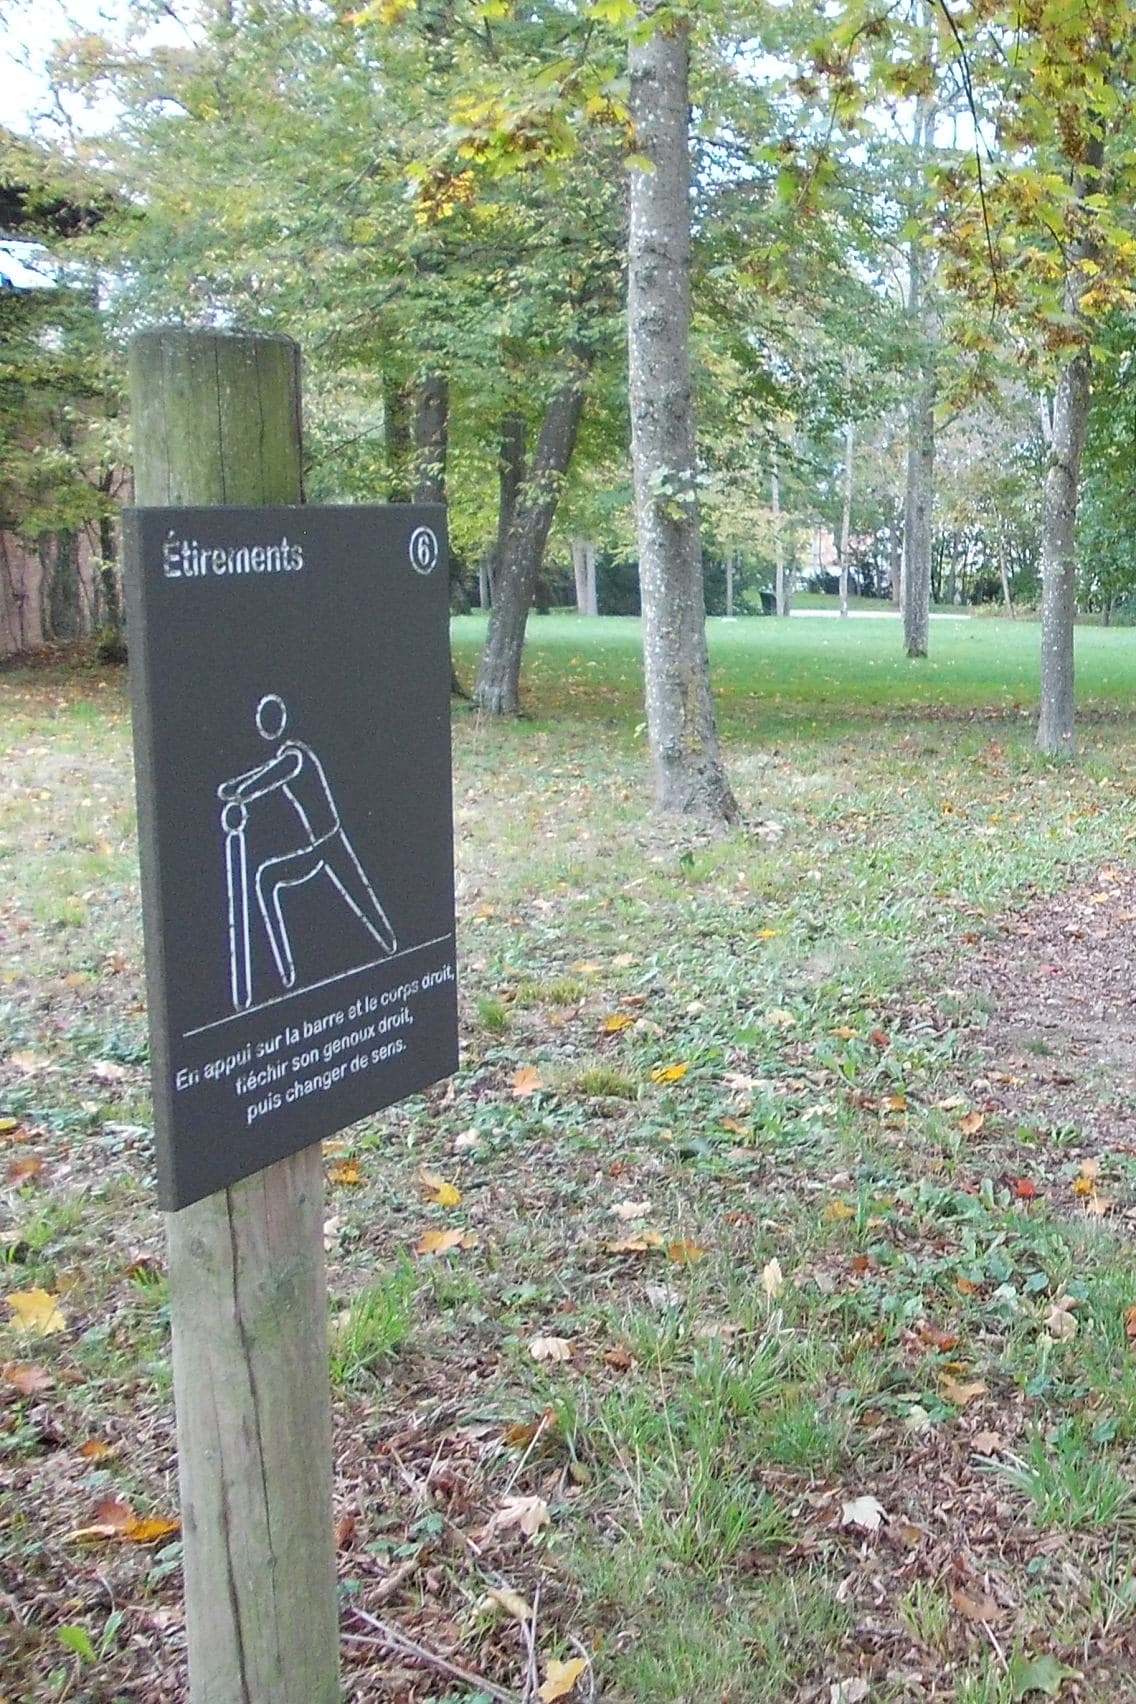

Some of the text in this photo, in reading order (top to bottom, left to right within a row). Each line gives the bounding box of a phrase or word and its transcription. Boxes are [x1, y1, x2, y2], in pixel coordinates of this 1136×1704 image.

[162, 529, 303, 579] Étirements
[417, 534, 430, 566] 6
[175, 963, 455, 1092] En appui sur la barre et le corps droit,
[291, 1050, 320, 1072] son
[322, 1026, 376, 1062] genoux
[378, 1007, 414, 1034] droit,
[246, 1041, 407, 1125] puis changer de sens.
